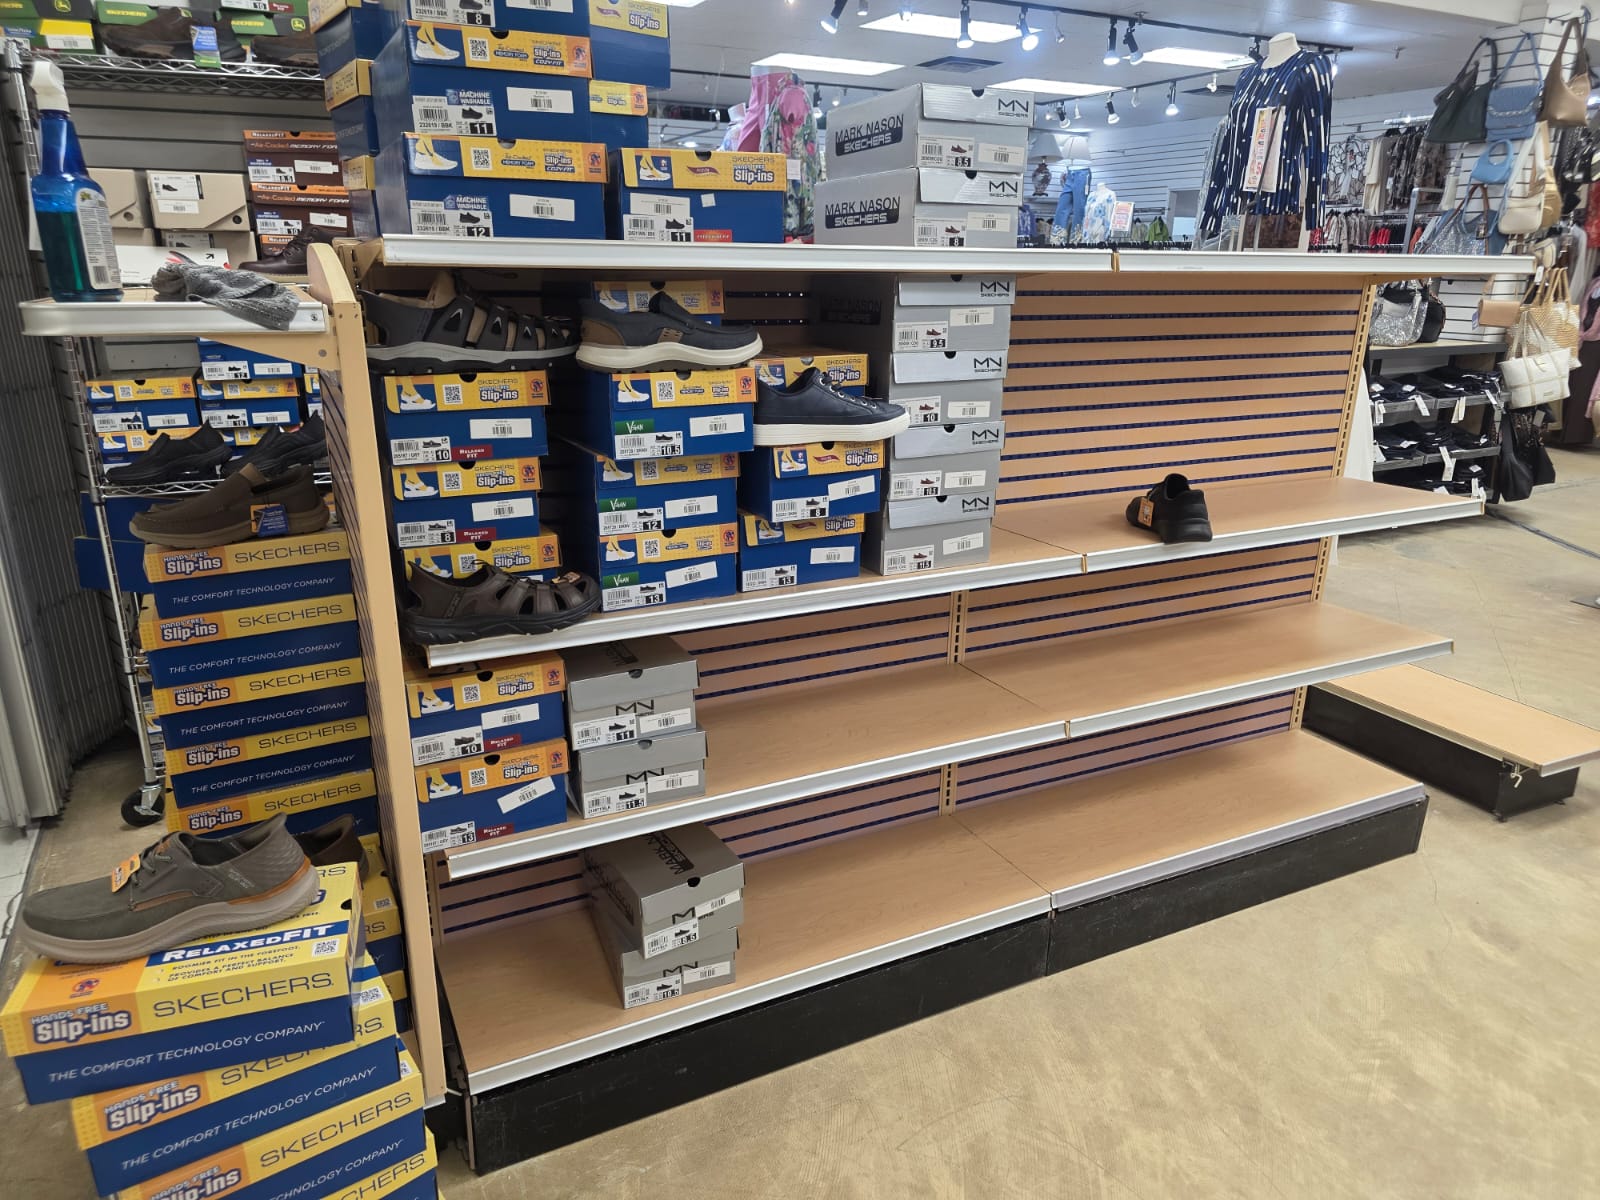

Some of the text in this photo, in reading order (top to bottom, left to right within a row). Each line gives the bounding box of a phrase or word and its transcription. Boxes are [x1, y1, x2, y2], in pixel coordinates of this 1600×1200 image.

[475, 13, 483, 24] 8
[629, 14, 660, 30] Slip-ins
[534, 48, 561, 59] Slip-ins
[459, 91, 490, 99] MACHINE
[460, 98, 491, 106] WASHABLE
[998, 98, 1029, 112] MN
[473, 123, 487, 134] 11
[835, 113, 904, 144] MARK NASON
[843, 132, 892, 153] SKECHERS
[546, 156, 572, 166] Slip-ins
[734, 170, 774, 184] Slip-ins
[989, 181, 1018, 194] MN
[456, 196, 488, 204] MACHINE
[825, 196, 900, 216] MARK NASON
[834, 212, 888, 226] SKECHERS
[472, 226, 486, 238] 12
[674, 232, 686, 242] 11
[980, 280, 1010, 292] MN
[974, 356, 1002, 368] MN
[478, 378, 519, 386] SKECHERS
[828, 369, 860, 382] Slip-ins
[480, 390, 518, 402] Slip-ins
[926, 413, 936, 422] 10
[972, 428, 999, 440] MN
[437, 450, 449, 459] 10
[662, 445, 680, 455] 10.5
[846, 452, 878, 466] Slip-ins
[477, 476, 514, 488] Slip-ins
[962, 496, 990, 509] MN
[815, 508, 821, 517] 8
[646, 521, 656, 530] 12
[825, 518, 855, 531] Slip-ins
[444, 533, 450, 542] 8
[234, 541, 340, 563] SKECHERS
[166, 557, 222, 575] Slip-ins
[495, 556, 531, 568] Slip-ins
[781, 577, 792, 585] 13
[172, 576, 335, 604] THE COMFORT TECHNOLOGY COMPANY
[648, 594, 660, 604] 13
[238, 604, 343, 628] SKECHERS
[162, 623, 218, 641] Slip-ins
[168, 642, 342, 674] THE COMFORT TECHNOLOGY COMPANY
[249, 666, 352, 692] SKECHERS
[498, 682, 534, 695] Slip-ins
[176, 687, 230, 706] Slip-ins
[615, 699, 654, 716] MN
[180, 701, 348, 736] THE COMFORT TECHNOLOGY COMPANY
[258, 722, 358, 749] SKECHERS
[187, 747, 240, 765] Slip-ins
[464, 744, 478, 754] 10
[191, 754, 355, 794] THE COMFORT TECHNOLOGY COMPANY
[504, 765, 539, 778] Slip-ins
[626, 767, 664, 785] MN
[264, 783, 362, 812] SKECHERS
[190, 810, 241, 830] Slip-ins
[463, 832, 474, 842] 13
[168, 967, 210, 978] PROVIDES
[222, 960, 252, 970] PERFECT
[252, 952, 294, 964] BALANCE
[172, 960, 212, 971] ROOMIER
[180, 970, 223, 980] COMFORT
[224, 966, 244, 975] AND
[153, 972, 334, 1018] SKECHERS
[31, 1002, 108, 1025] HANDS FREE
[34, 1010, 130, 1044] Slip-ins
[48, 1021, 323, 1082] THE COMFORT TECHNOLOGY COMPANY
[103, 1079, 181, 1114] HANDS FREE
[107, 1084, 200, 1132] Slip-ins
[121, 1066, 377, 1170] THE COMFORT TECHNOLOGY COMPANY
[260, 1092, 412, 1167] SKECHERS
[344, 1139, 403, 1172] COMPANY
[151, 1166, 221, 1200] HANDS FREE
